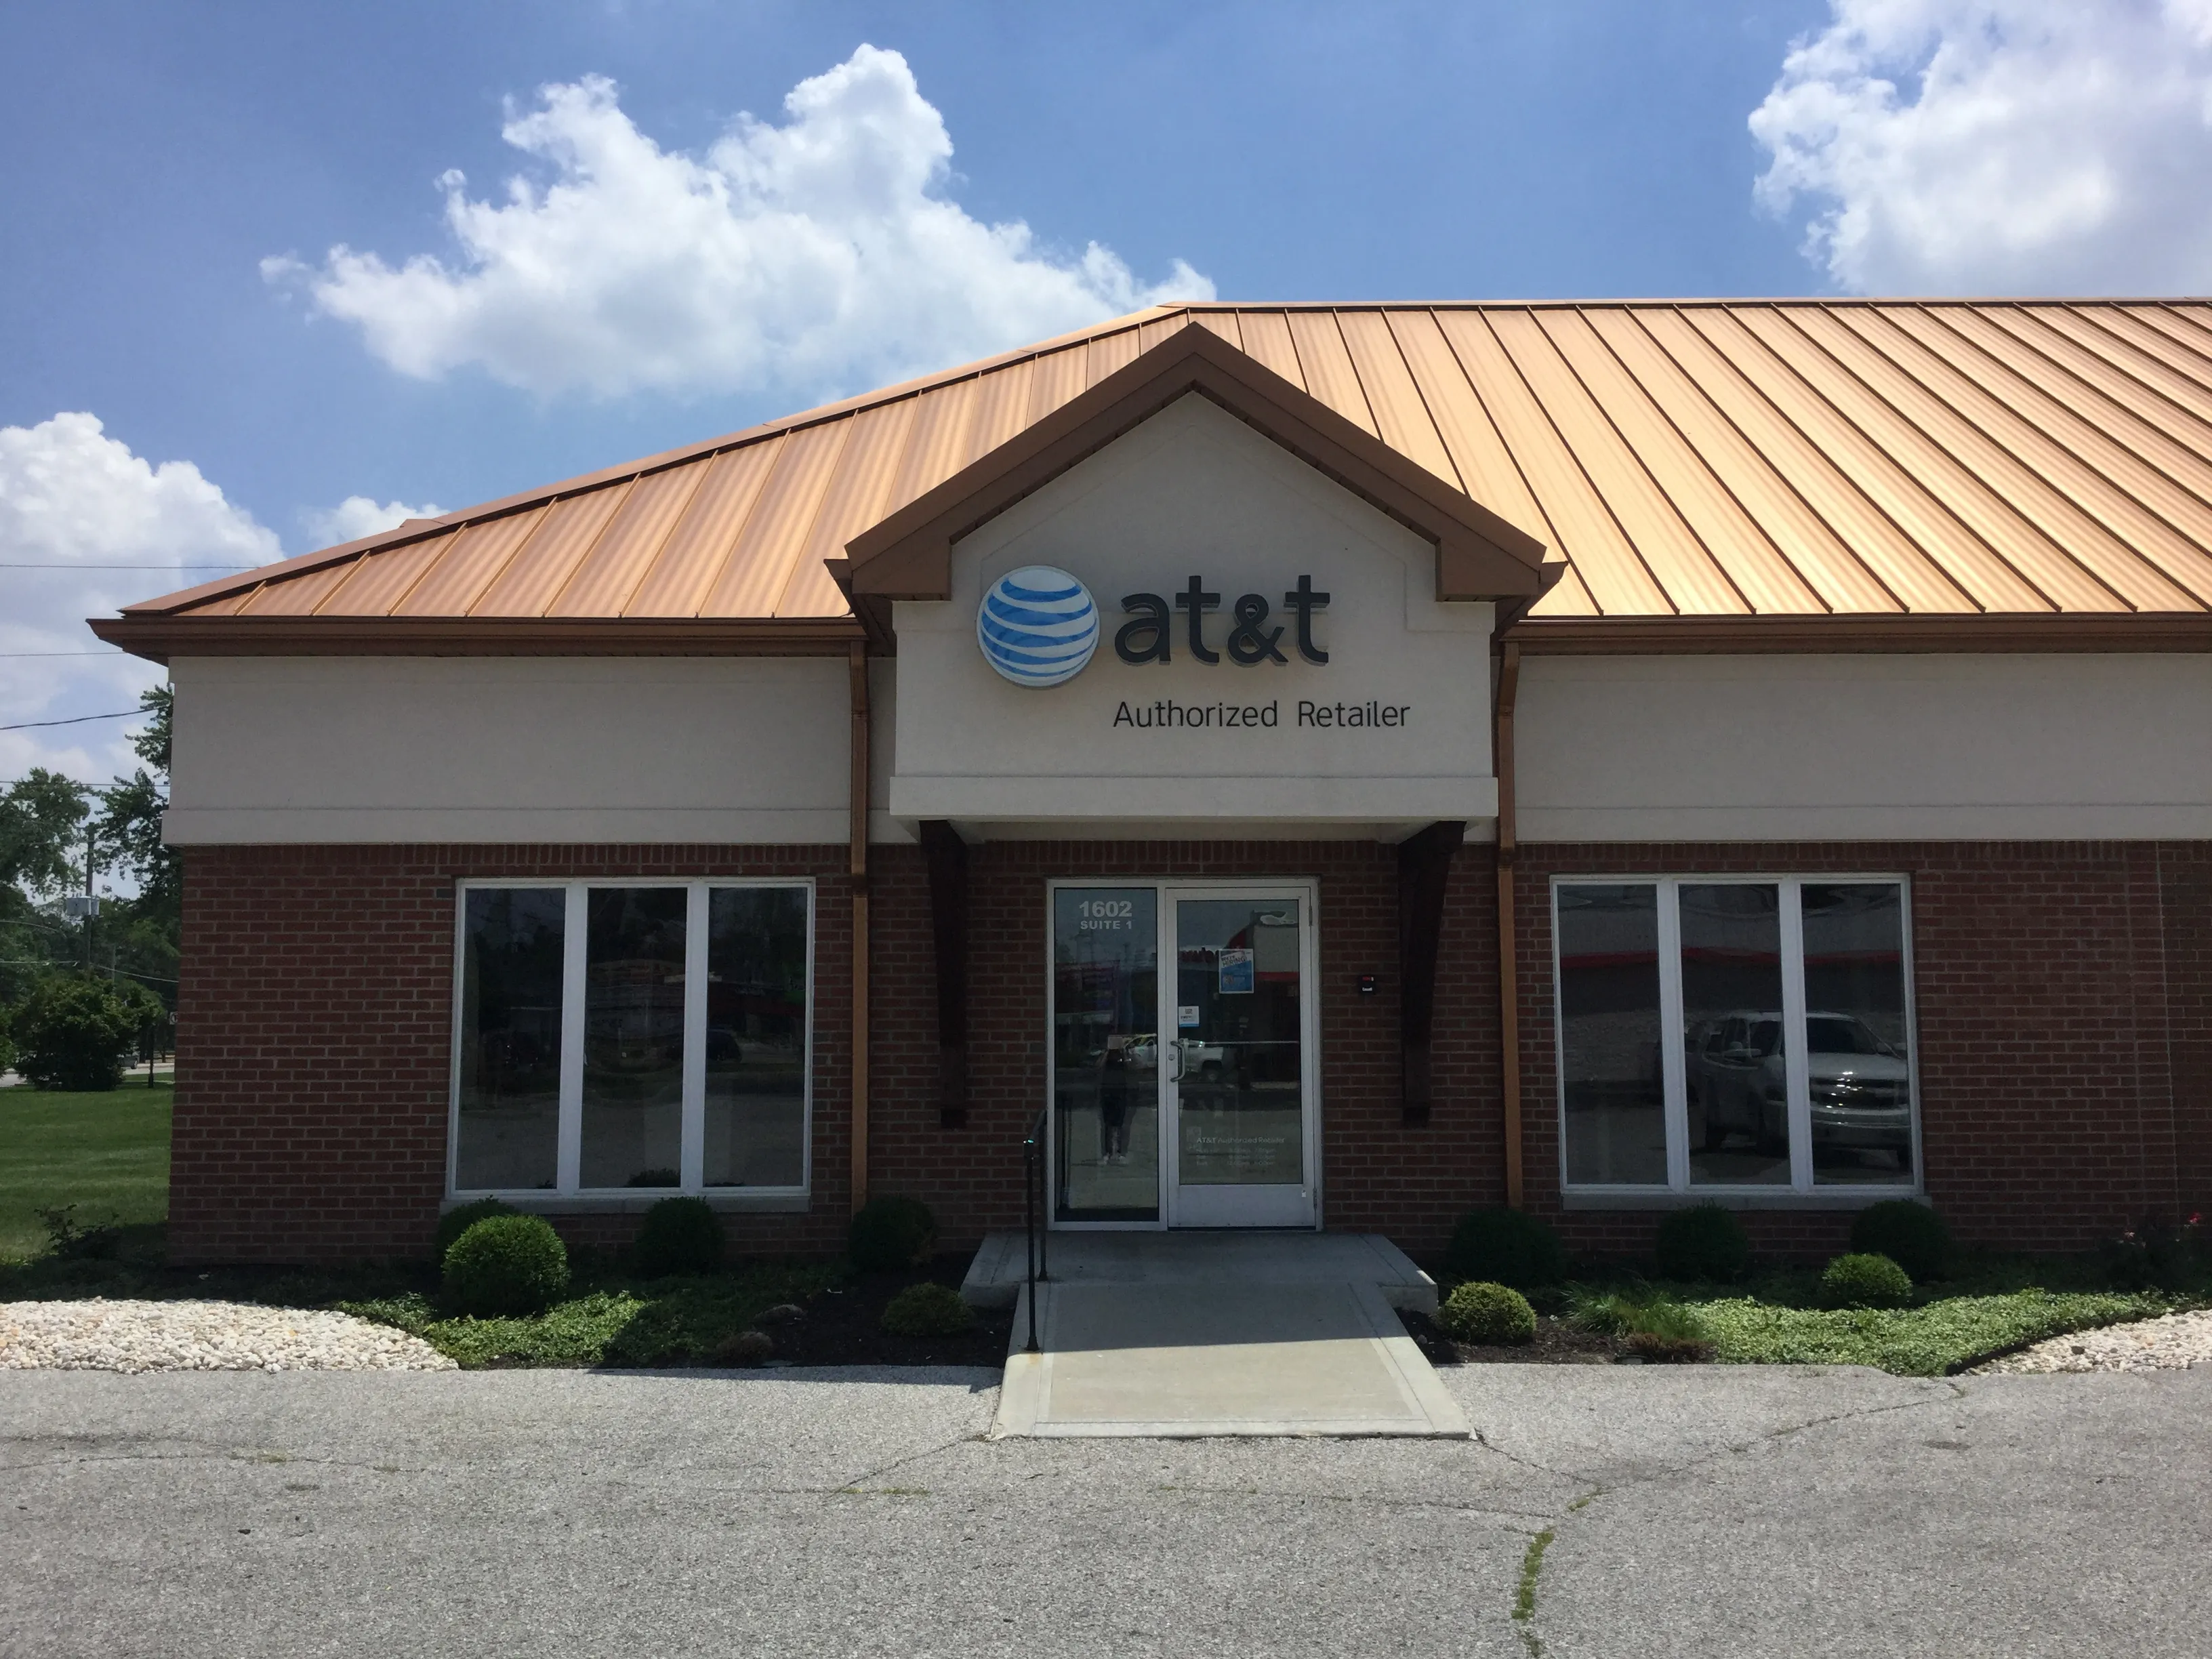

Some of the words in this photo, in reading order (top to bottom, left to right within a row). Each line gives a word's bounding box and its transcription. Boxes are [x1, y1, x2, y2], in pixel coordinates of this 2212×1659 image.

[1114, 575, 1330, 664] at&t
[1113, 700, 1277, 727] Authorized
[1298, 701, 1410, 727] Retailer
[1079, 901, 1132, 917] 1602
[1080, 920, 1121, 930] SUITE
[1126, 920, 1132, 930] 1
